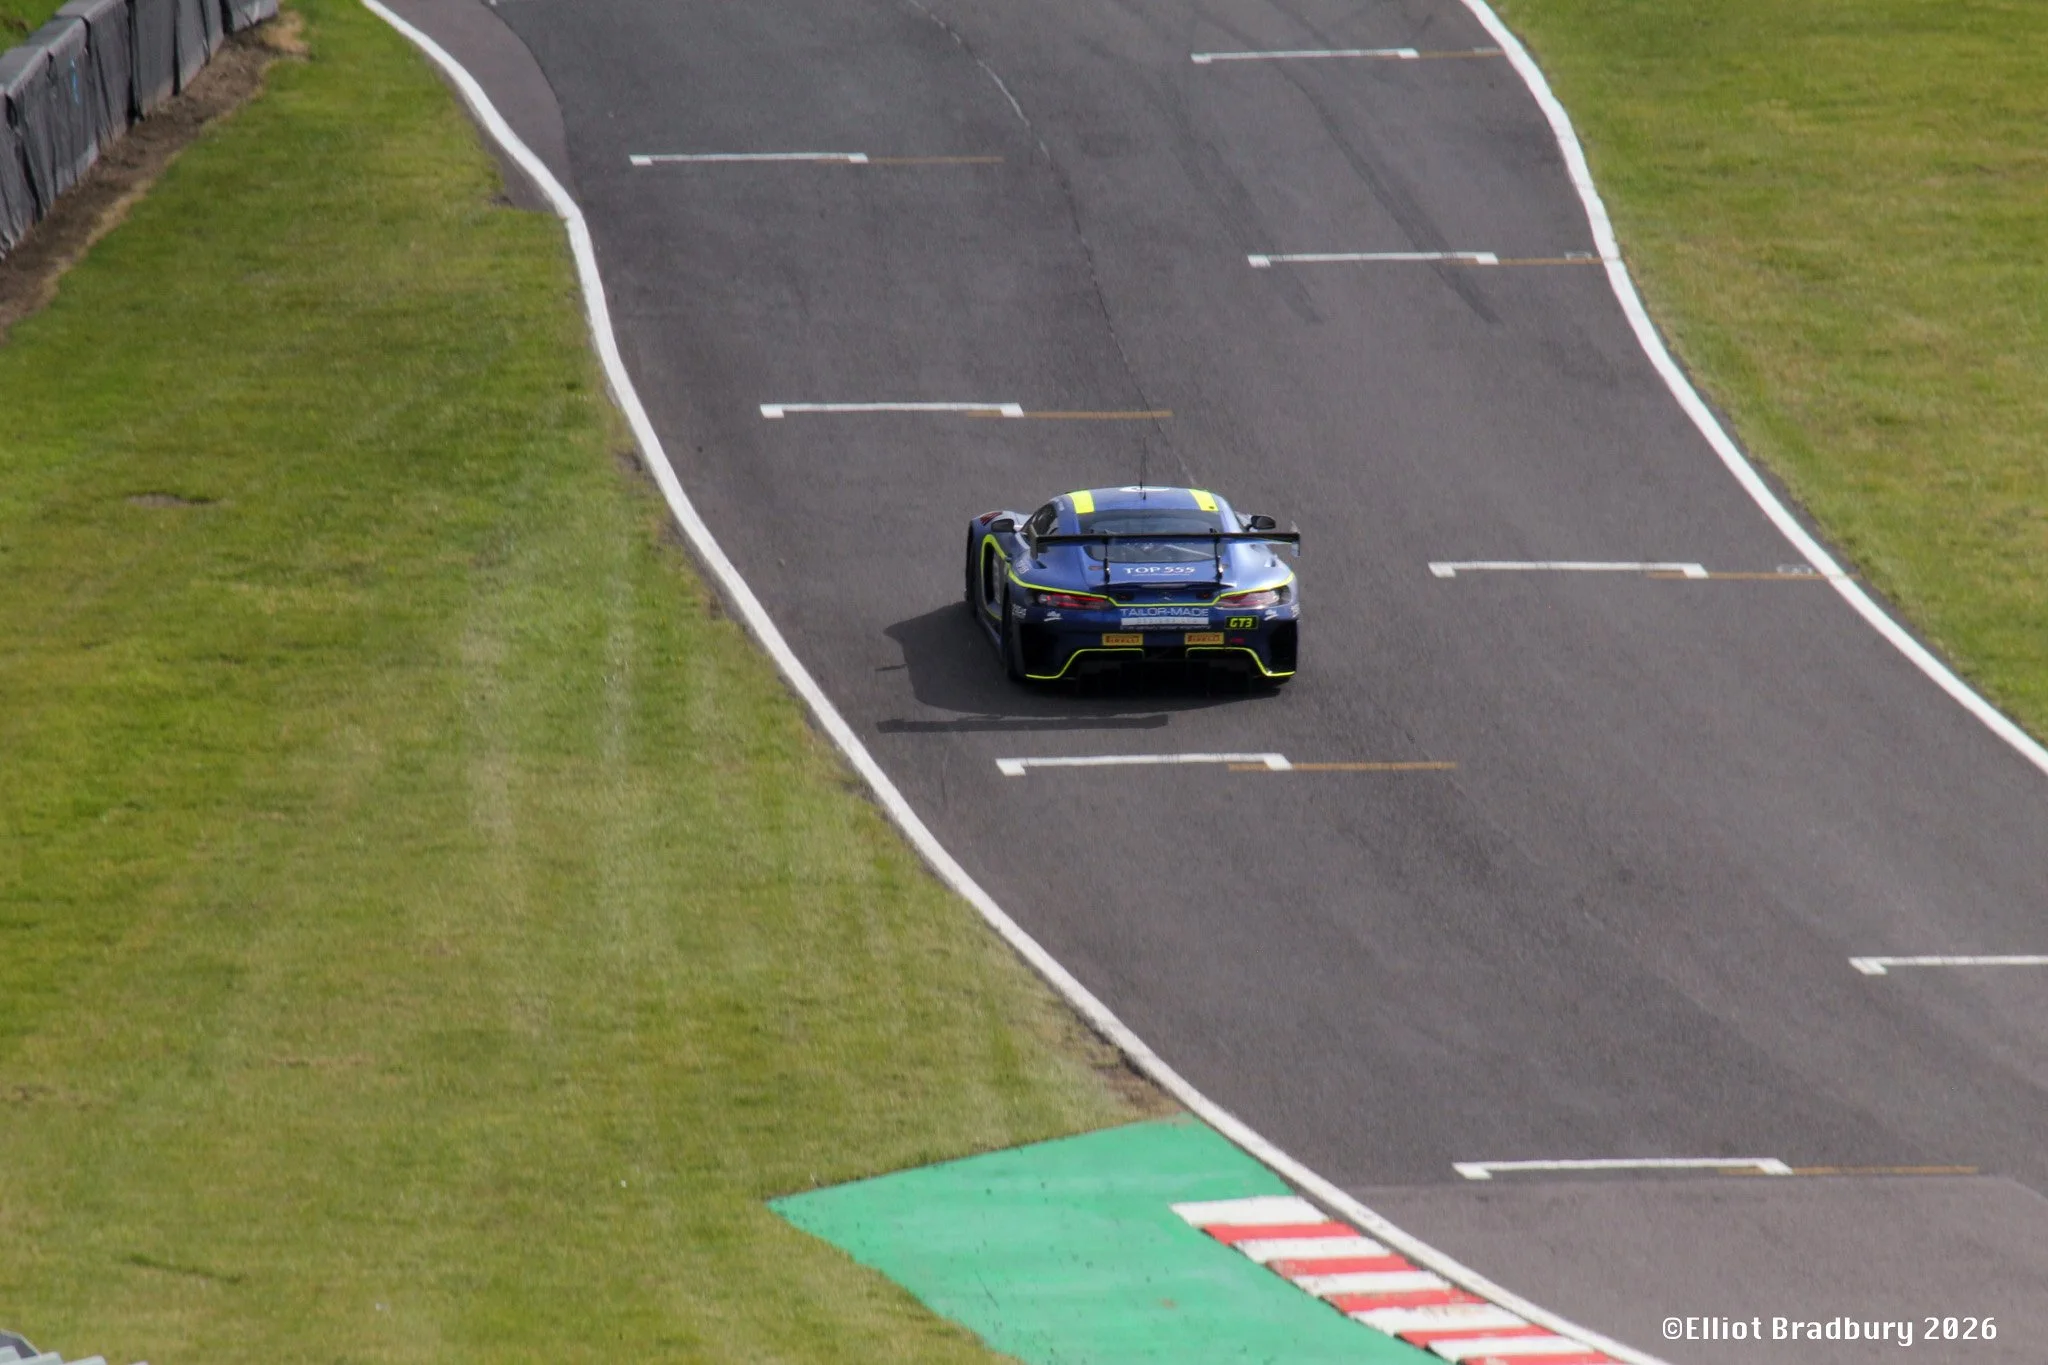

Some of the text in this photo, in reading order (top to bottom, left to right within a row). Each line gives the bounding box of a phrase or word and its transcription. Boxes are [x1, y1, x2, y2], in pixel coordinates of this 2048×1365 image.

[1122, 566, 1161, 574] TOP
[1119, 607, 1209, 617] TAILOR-MADE
[1229, 617, 1253, 628] GT3
[1105, 635, 1140, 643] PIRELLI
[1187, 633, 1220, 642] PIRELLI
